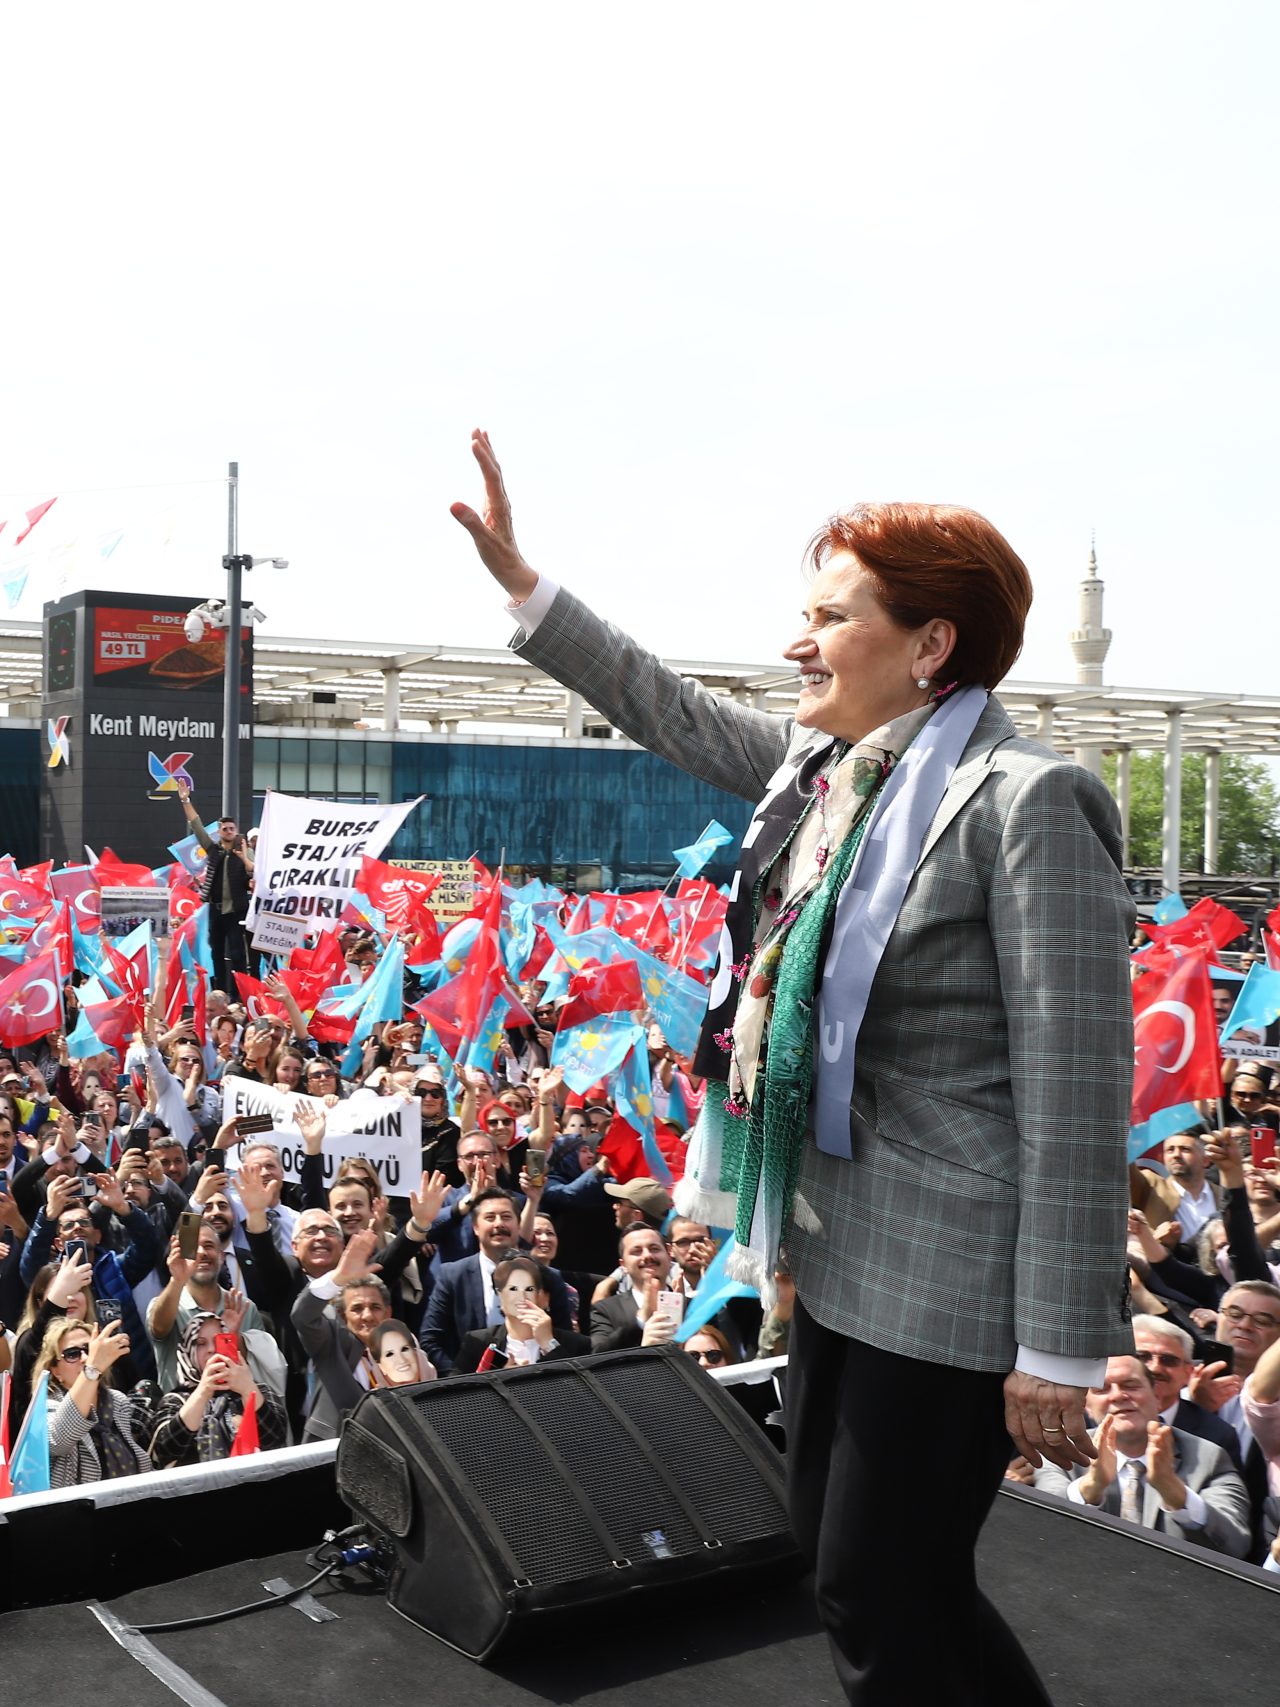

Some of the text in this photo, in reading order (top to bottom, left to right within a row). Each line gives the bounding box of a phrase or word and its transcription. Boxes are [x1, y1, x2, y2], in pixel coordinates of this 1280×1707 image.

[105, 643, 141, 655] 49 TL
[90, 713, 133, 736] Kent
[139, 715, 216, 742] Meydanı
[304, 818, 380, 837] BURSA
[282, 841, 367, 862] STAJ VE
[256, 890, 344, 919] AĞDUR
[1241, 1048, 1278, 1058] ADALET
